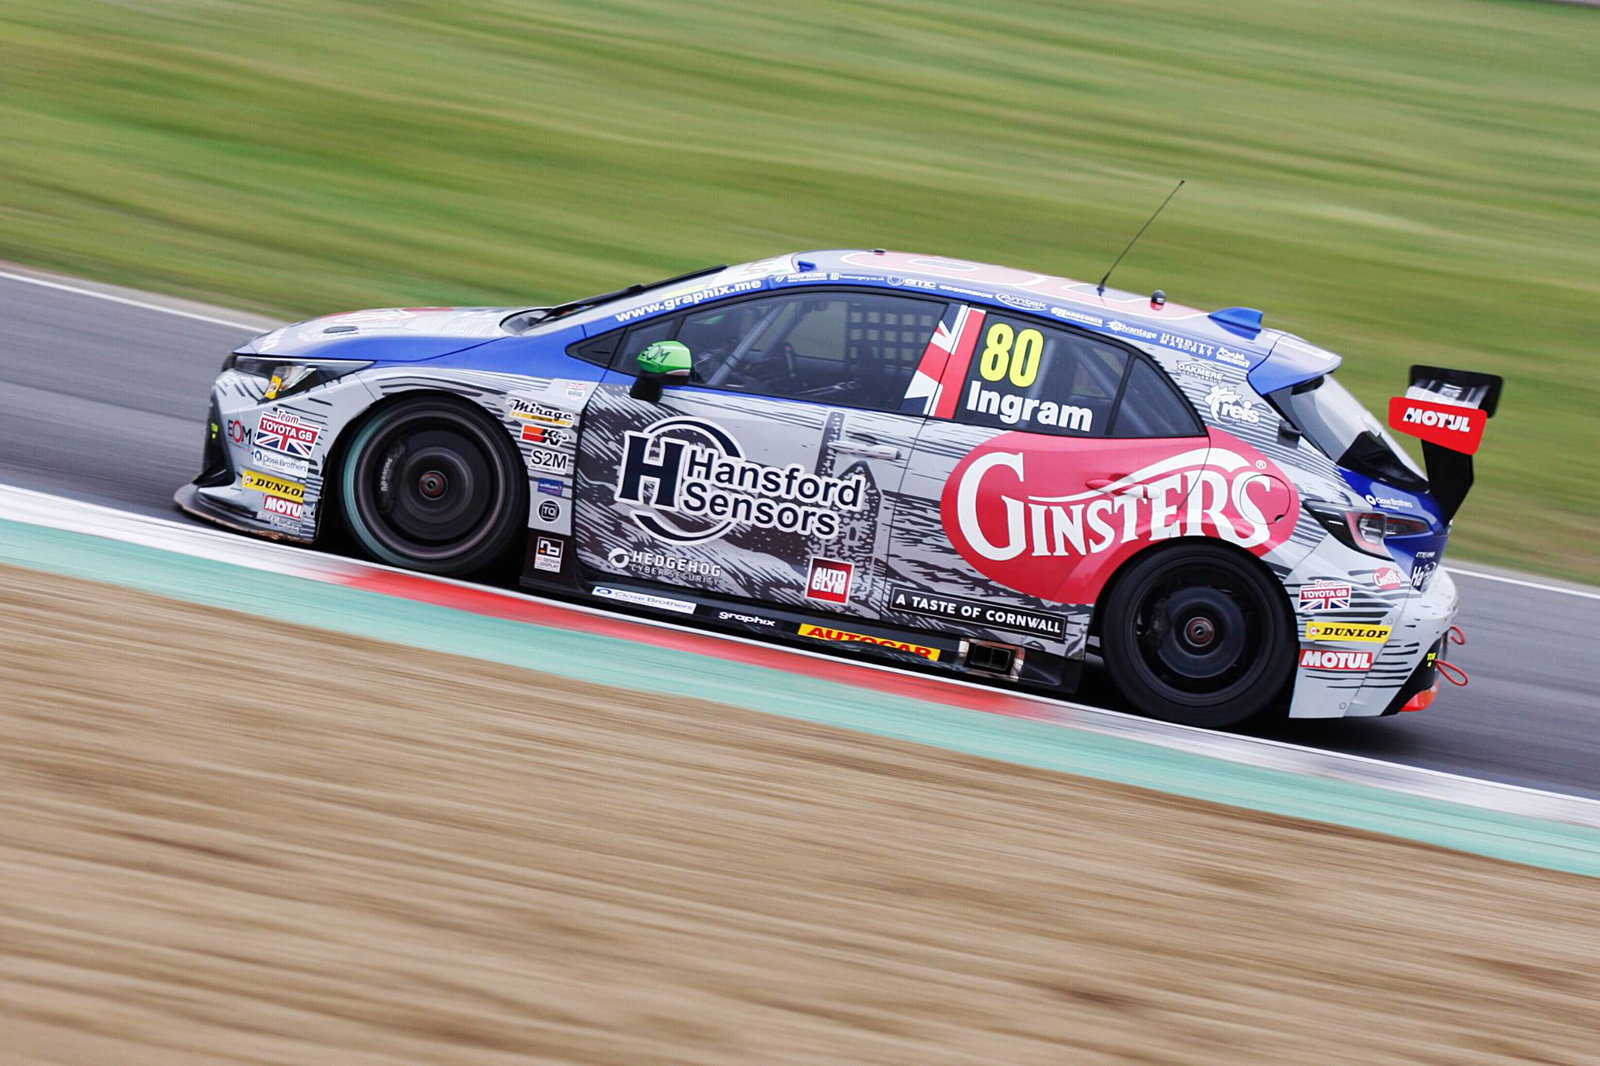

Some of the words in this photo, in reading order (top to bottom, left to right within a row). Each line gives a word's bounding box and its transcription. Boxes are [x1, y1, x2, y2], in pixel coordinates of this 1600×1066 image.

[614, 280, 762, 322] www.graphix.me
[979, 322, 1044, 388] 80
[1178, 363, 1223, 380] OAKMERE
[511, 398, 573, 421] Mirage
[966, 380, 1093, 432] Ingram
[1221, 400, 1260, 424] reis
[277, 410, 300, 424] Team
[1402, 407, 1471, 433] MOTUL
[262, 420, 297, 438] TOYOTA
[298, 429, 313, 441] GB
[280, 460, 307, 472] Brothers
[531, 450, 568, 469] S2M
[687, 449, 862, 507] Hansford
[683, 482, 836, 535] Sensors
[631, 563, 664, 576] CYBER
[669, 571, 719, 585] SECURITY
[632, 551, 721, 577] HEDGEHOG
[814, 567, 848, 584] AUTO
[811, 578, 846, 595] GLYM
[1302, 589, 1335, 598] TOYOTA
[1336, 589, 1348, 597] GB
[613, 590, 645, 600] Close
[646, 596, 693, 610] Brothers
[719, 611, 776, 627] graphix
[895, 594, 906, 605] A
[911, 596, 957, 614] TASTE
[960, 605, 982, 618] OF
[985, 610, 1061, 633] CORNWALL
[1322, 627, 1388, 639] DUNLOP
[1301, 651, 1372, 669] MOTUL
